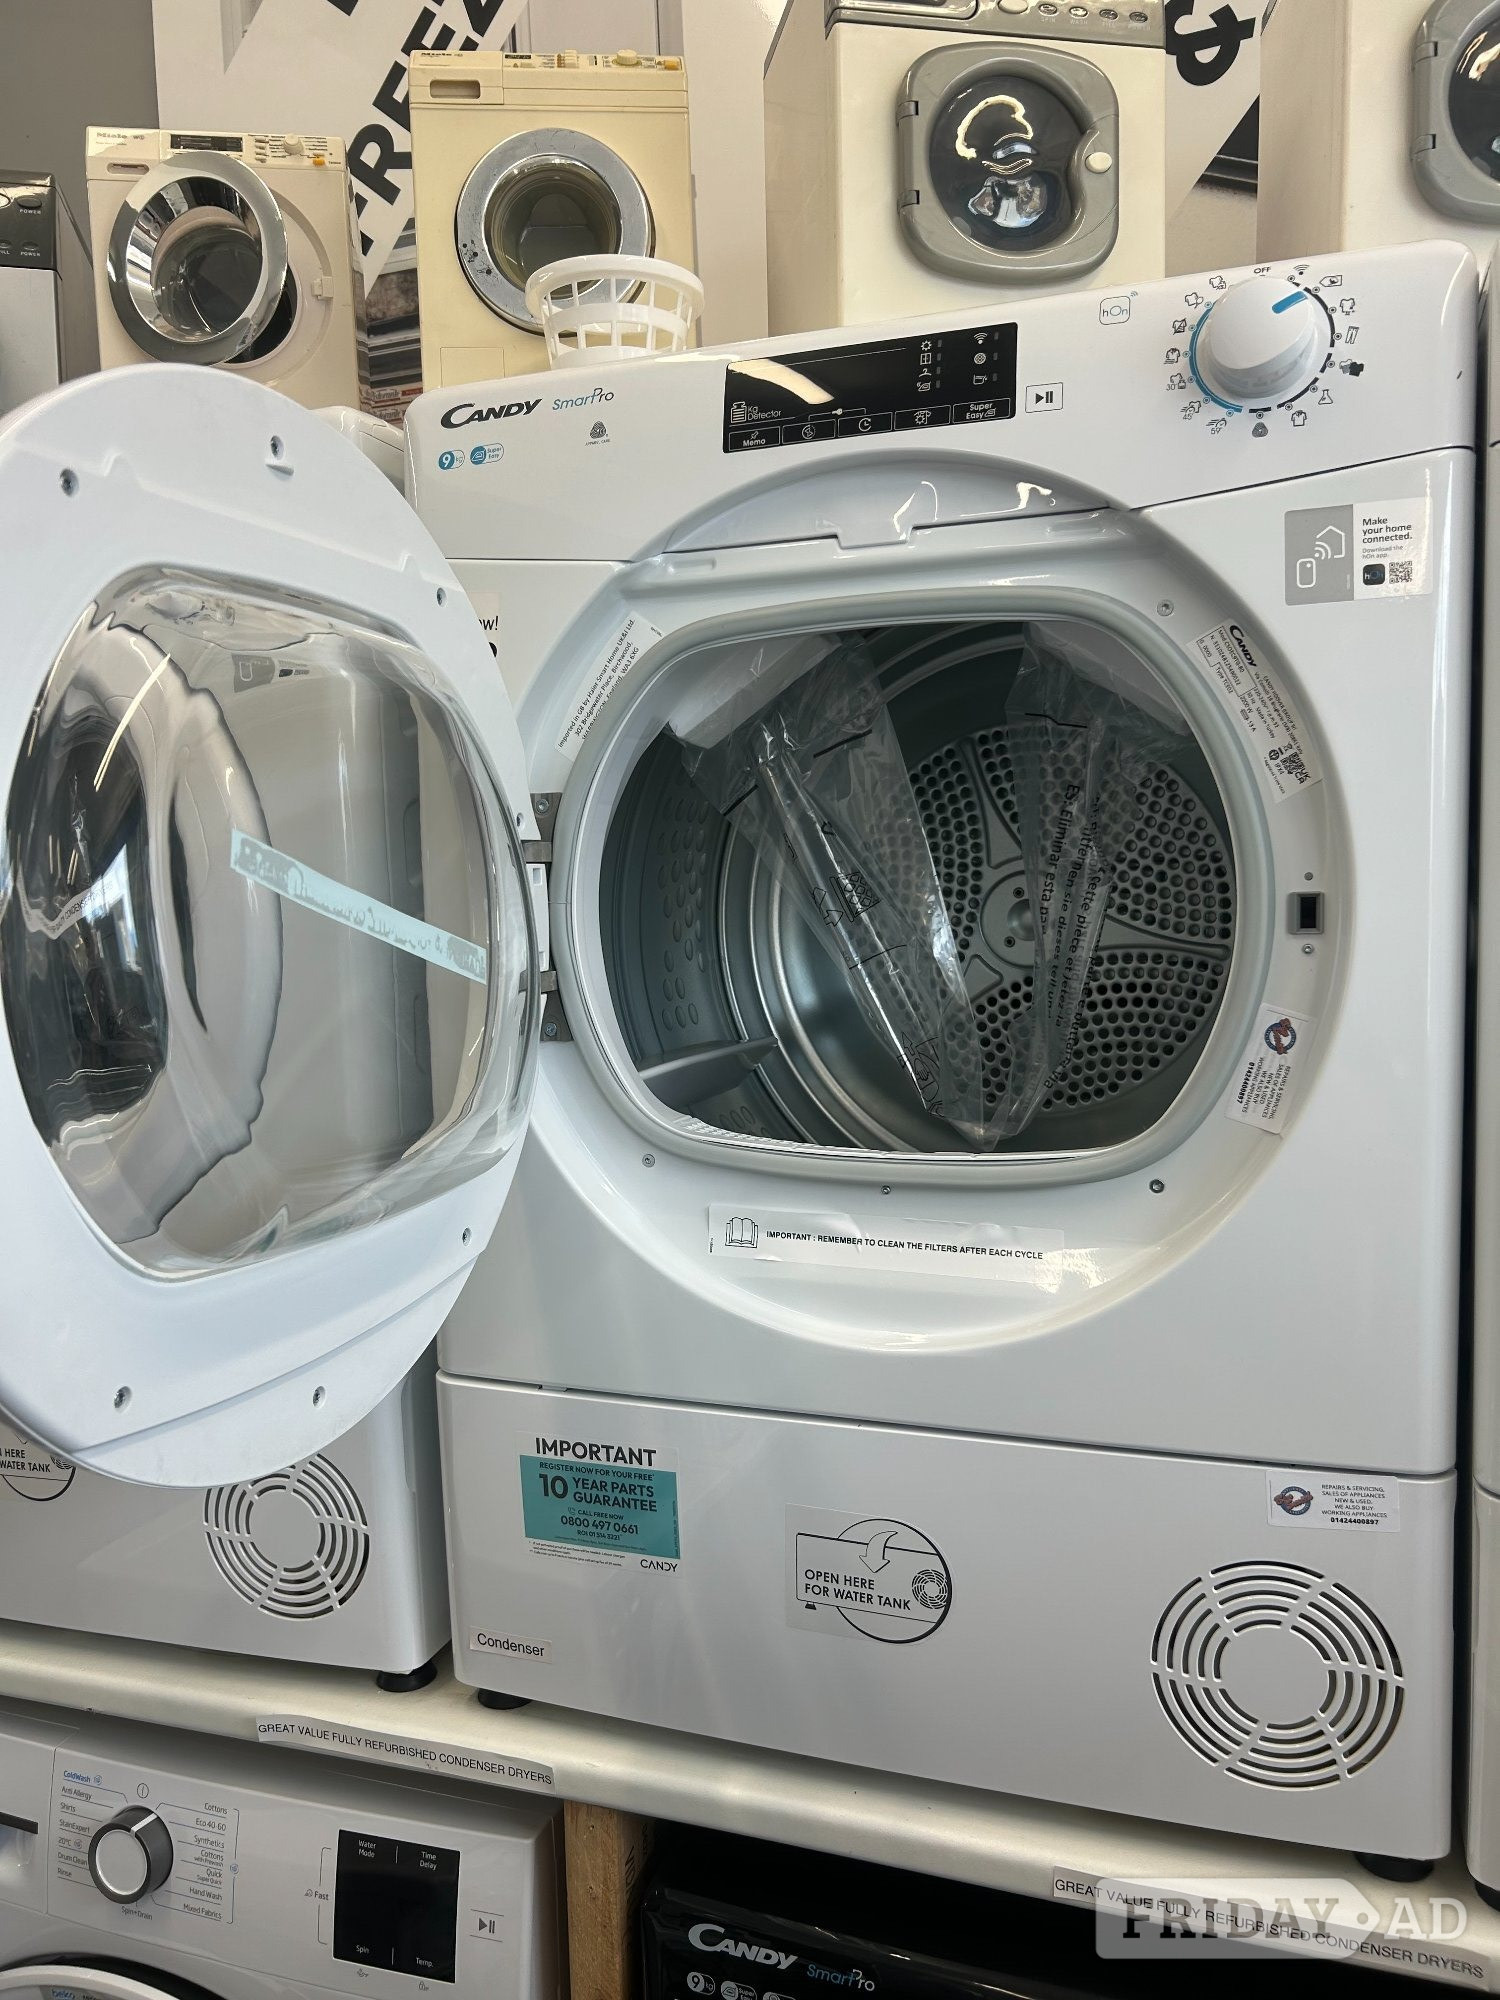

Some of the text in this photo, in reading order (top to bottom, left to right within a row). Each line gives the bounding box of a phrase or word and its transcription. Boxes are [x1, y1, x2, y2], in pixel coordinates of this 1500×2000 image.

[1254, 266, 1272, 274] OFF
[1102, 305, 1128, 317] hOn
[440, 398, 543, 429] CANDY
[748, 405, 759, 415] Kg
[969, 402, 993, 412] Super
[747, 408, 782, 421] Detector
[965, 410, 984, 421] Easy
[742, 436, 766, 448] Memo
[442, 453, 451, 468] 9
[1362, 516, 1388, 526] Make
[1362, 524, 1412, 536] your home
[1362, 532, 1413, 544] connected.
[1362, 546, 1393, 554] Download
[1229, 624, 1257, 667] CANDY
[628, 647, 640, 662] 6XG
[557, 716, 576, 748] Imported
[573, 711, 580, 721] in
[578, 706, 585, 717] GB
[584, 696, 591, 707] by
[596, 663, 610, 683] Smart
[606, 647, 620, 666] Home
[626, 619, 636, 633] Ltd.
[581, 685, 604, 726] Bridgewater
[601, 670, 615, 691] Place,
[1049, 809, 1073, 871] Eliminar
[1041, 871, 1056, 904] esta
[1275, 1064, 1283, 1078] SALES
[1236, 1062, 1255, 1104] 01424400897
[766, 1230, 1044, 1260] IMPORTANT REMEMBER TO CLEAN THE FILTERS AFTER EACH CYCLE
[4, 1447, 26, 1459] HERE
[535, 1437, 657, 1467] IMPORTANT
[27, 1462, 51, 1473] TANK
[539, 1461, 575, 1473] REGISTER
[575, 1466, 594, 1475] NOW
[594, 1467, 611, 1477] FOR
[611, 1469, 633, 1479] YOUR
[538, 1473, 569, 1499] 10
[572, 1476, 655, 1498] YEAR PARTS
[573, 1491, 658, 1513] GUARANTEE
[577, 1509, 624, 1521] CALL FREE NOW
[1321, 1509, 1351, 1517] WORKING
[560, 1515, 639, 1535] 0800 497 0661
[1330, 1517, 1379, 1525] 01424400897
[640, 1558, 678, 1573] CANDY
[804, 1569, 875, 1591] OPEN HERE
[805, 1583, 911, 1611] FOR WATER TANK
[477, 1632, 545, 1657] Condenser
[258, 1723, 552, 1785] GREAT VALUE FULLY REFURBISHED CONDENSER DRYERS
[63, 1770, 91, 1784] ColdWash
[61, 1786, 92, 1801] Anti Allergy
[60, 1802, 76, 1813] Shirts
[204, 1802, 228, 1815] Cottons
[195, 1817, 208, 1828] Eco
[193, 1834, 225, 1849] Synthetics
[358, 1839, 377, 1849] Water
[57, 1851, 88, 1866] Drum Clean
[200, 1849, 224, 1862] Cottons
[358, 1848, 376, 1859] Mode
[421, 1851, 437, 1861] Time
[57, 1867, 73, 1878] Rinse
[419, 1860, 438, 1871] Delay
[206, 1868, 223, 1879] Quick
[189, 1886, 223, 1901] Hand Wash
[314, 1891, 330, 1901] Fast
[183, 1902, 222, 1920] Mixed Fabrics
[1054, 1878, 1485, 1980] GREAT VALUE FULLY REFURBISHED CONDENSER DRYERS
[355, 1944, 370, 1955] Spin
[687, 1922, 799, 1970] CANDY
[415, 1957, 434, 1968] Temp.
[691, 1974, 701, 1989] 9
